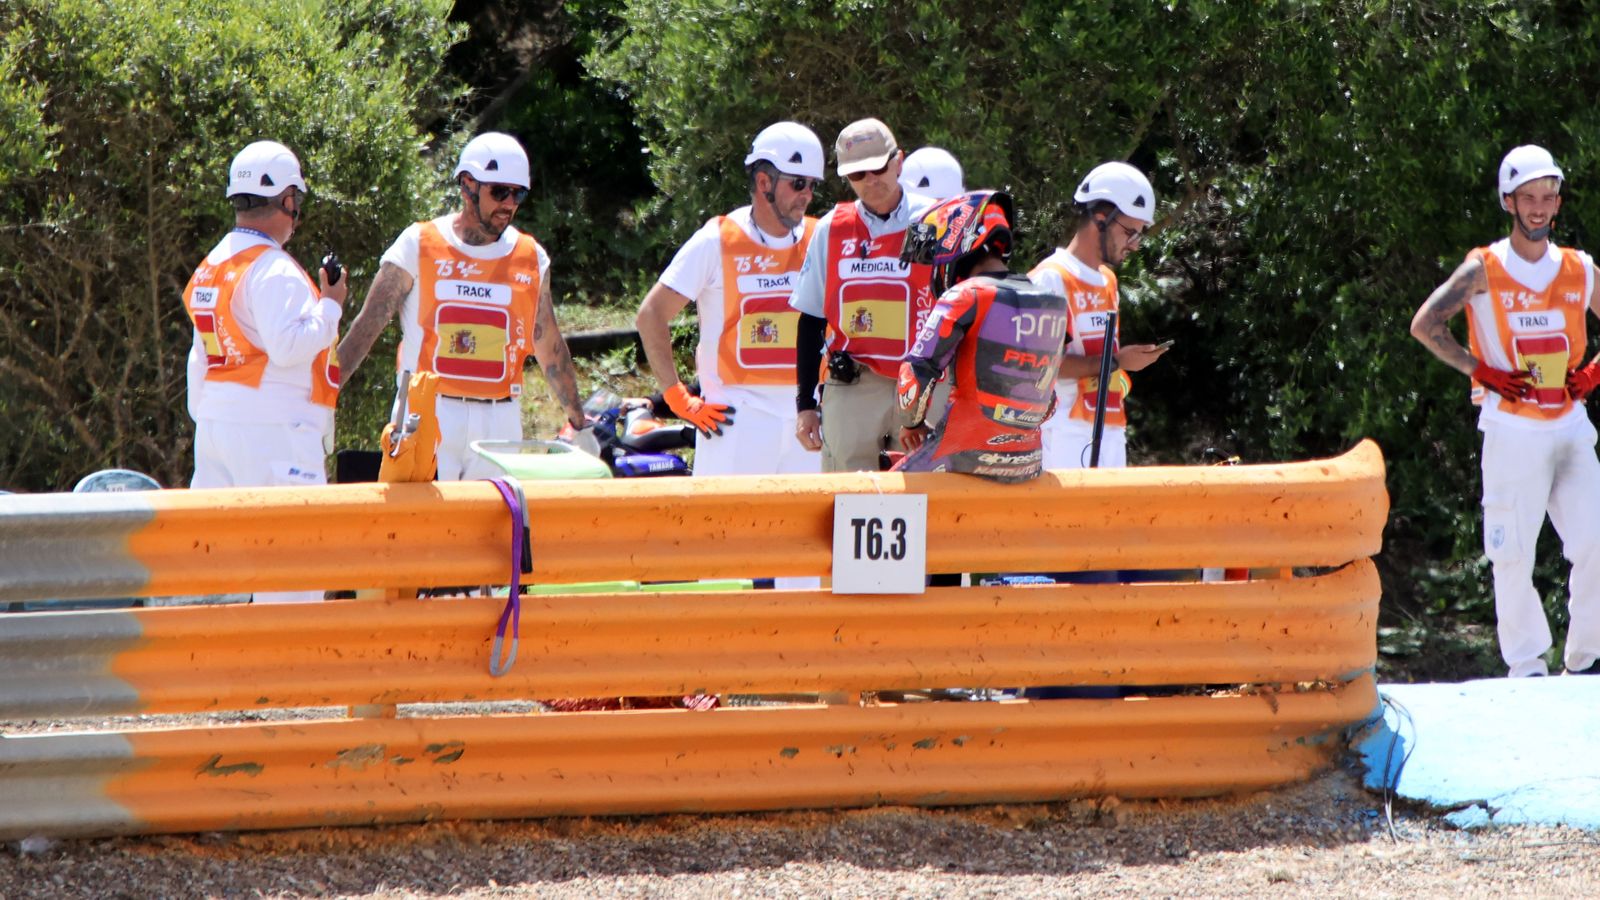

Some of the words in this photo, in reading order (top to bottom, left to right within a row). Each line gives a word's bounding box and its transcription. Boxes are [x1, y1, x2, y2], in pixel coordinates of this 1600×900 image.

[237, 170, 252, 178] 023
[941, 223, 960, 250] Red
[954, 203, 974, 228] Bull
[841, 238, 858, 256] 75
[434, 259, 454, 277] 75
[733, 256, 752, 273] 75
[850, 262, 897, 274] MEDICAL
[756, 275, 791, 289] TRACK
[456, 285, 492, 299] TRACK
[1003, 348, 1057, 368] PRA
[850, 517, 907, 561] T6.3
